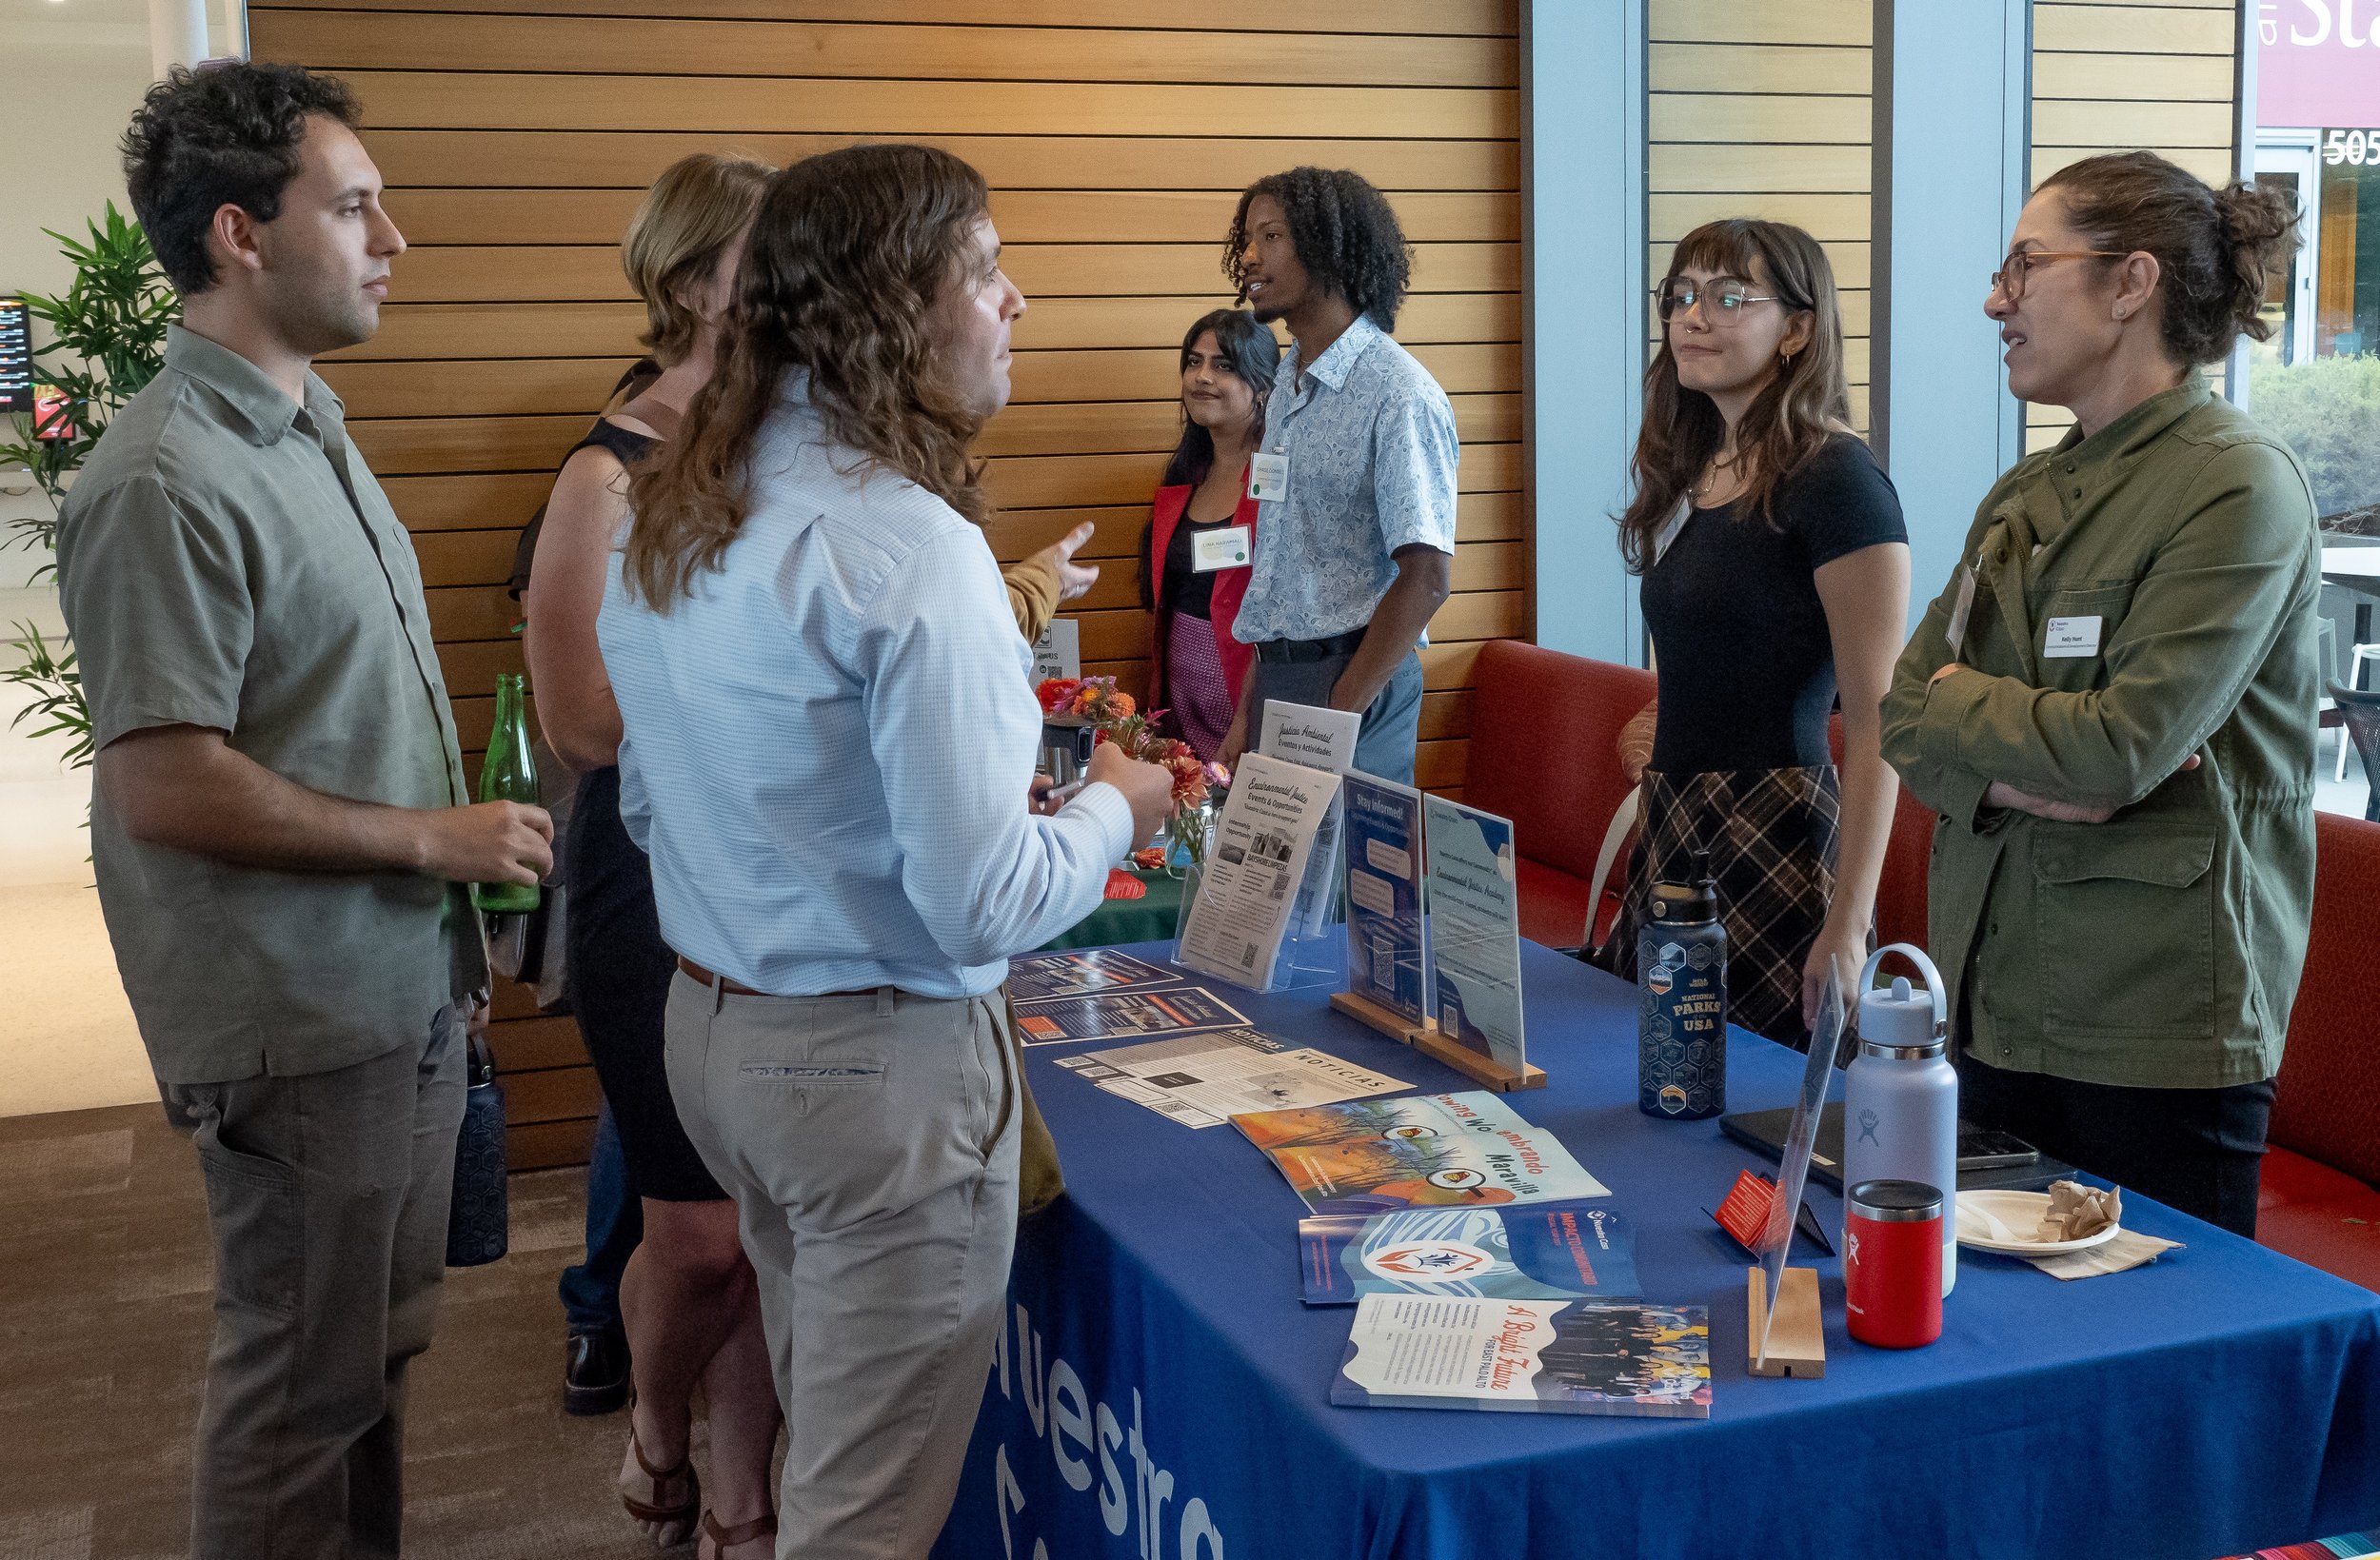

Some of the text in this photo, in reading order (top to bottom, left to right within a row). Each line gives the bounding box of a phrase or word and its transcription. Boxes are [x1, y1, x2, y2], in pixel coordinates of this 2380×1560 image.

[1300, 724, 1334, 744] Ambiental
[1278, 739, 1298, 750] Eventos
[1302, 742, 1332, 757] Actividades
[1248, 777, 1293, 797] Environmental
[1248, 792, 1267, 804] Events
[1272, 800, 1303, 815] Opportunities
[1357, 794, 1403, 819] Stay Informed!
[1681, 993, 1716, 1001] NATIONAL
[1673, 1001, 1721, 1017] PARKS
[1684, 1018, 1714, 1031] USA
[1294, 1054, 1385, 1088] NOTICIAS
[1496, 1129, 1550, 1175] embrando
[1492, 1319, 1536, 1353] Bright
[1475, 1338, 1497, 1389] FOR EAST PALO ALTO
[1490, 1355, 1530, 1391] Future
